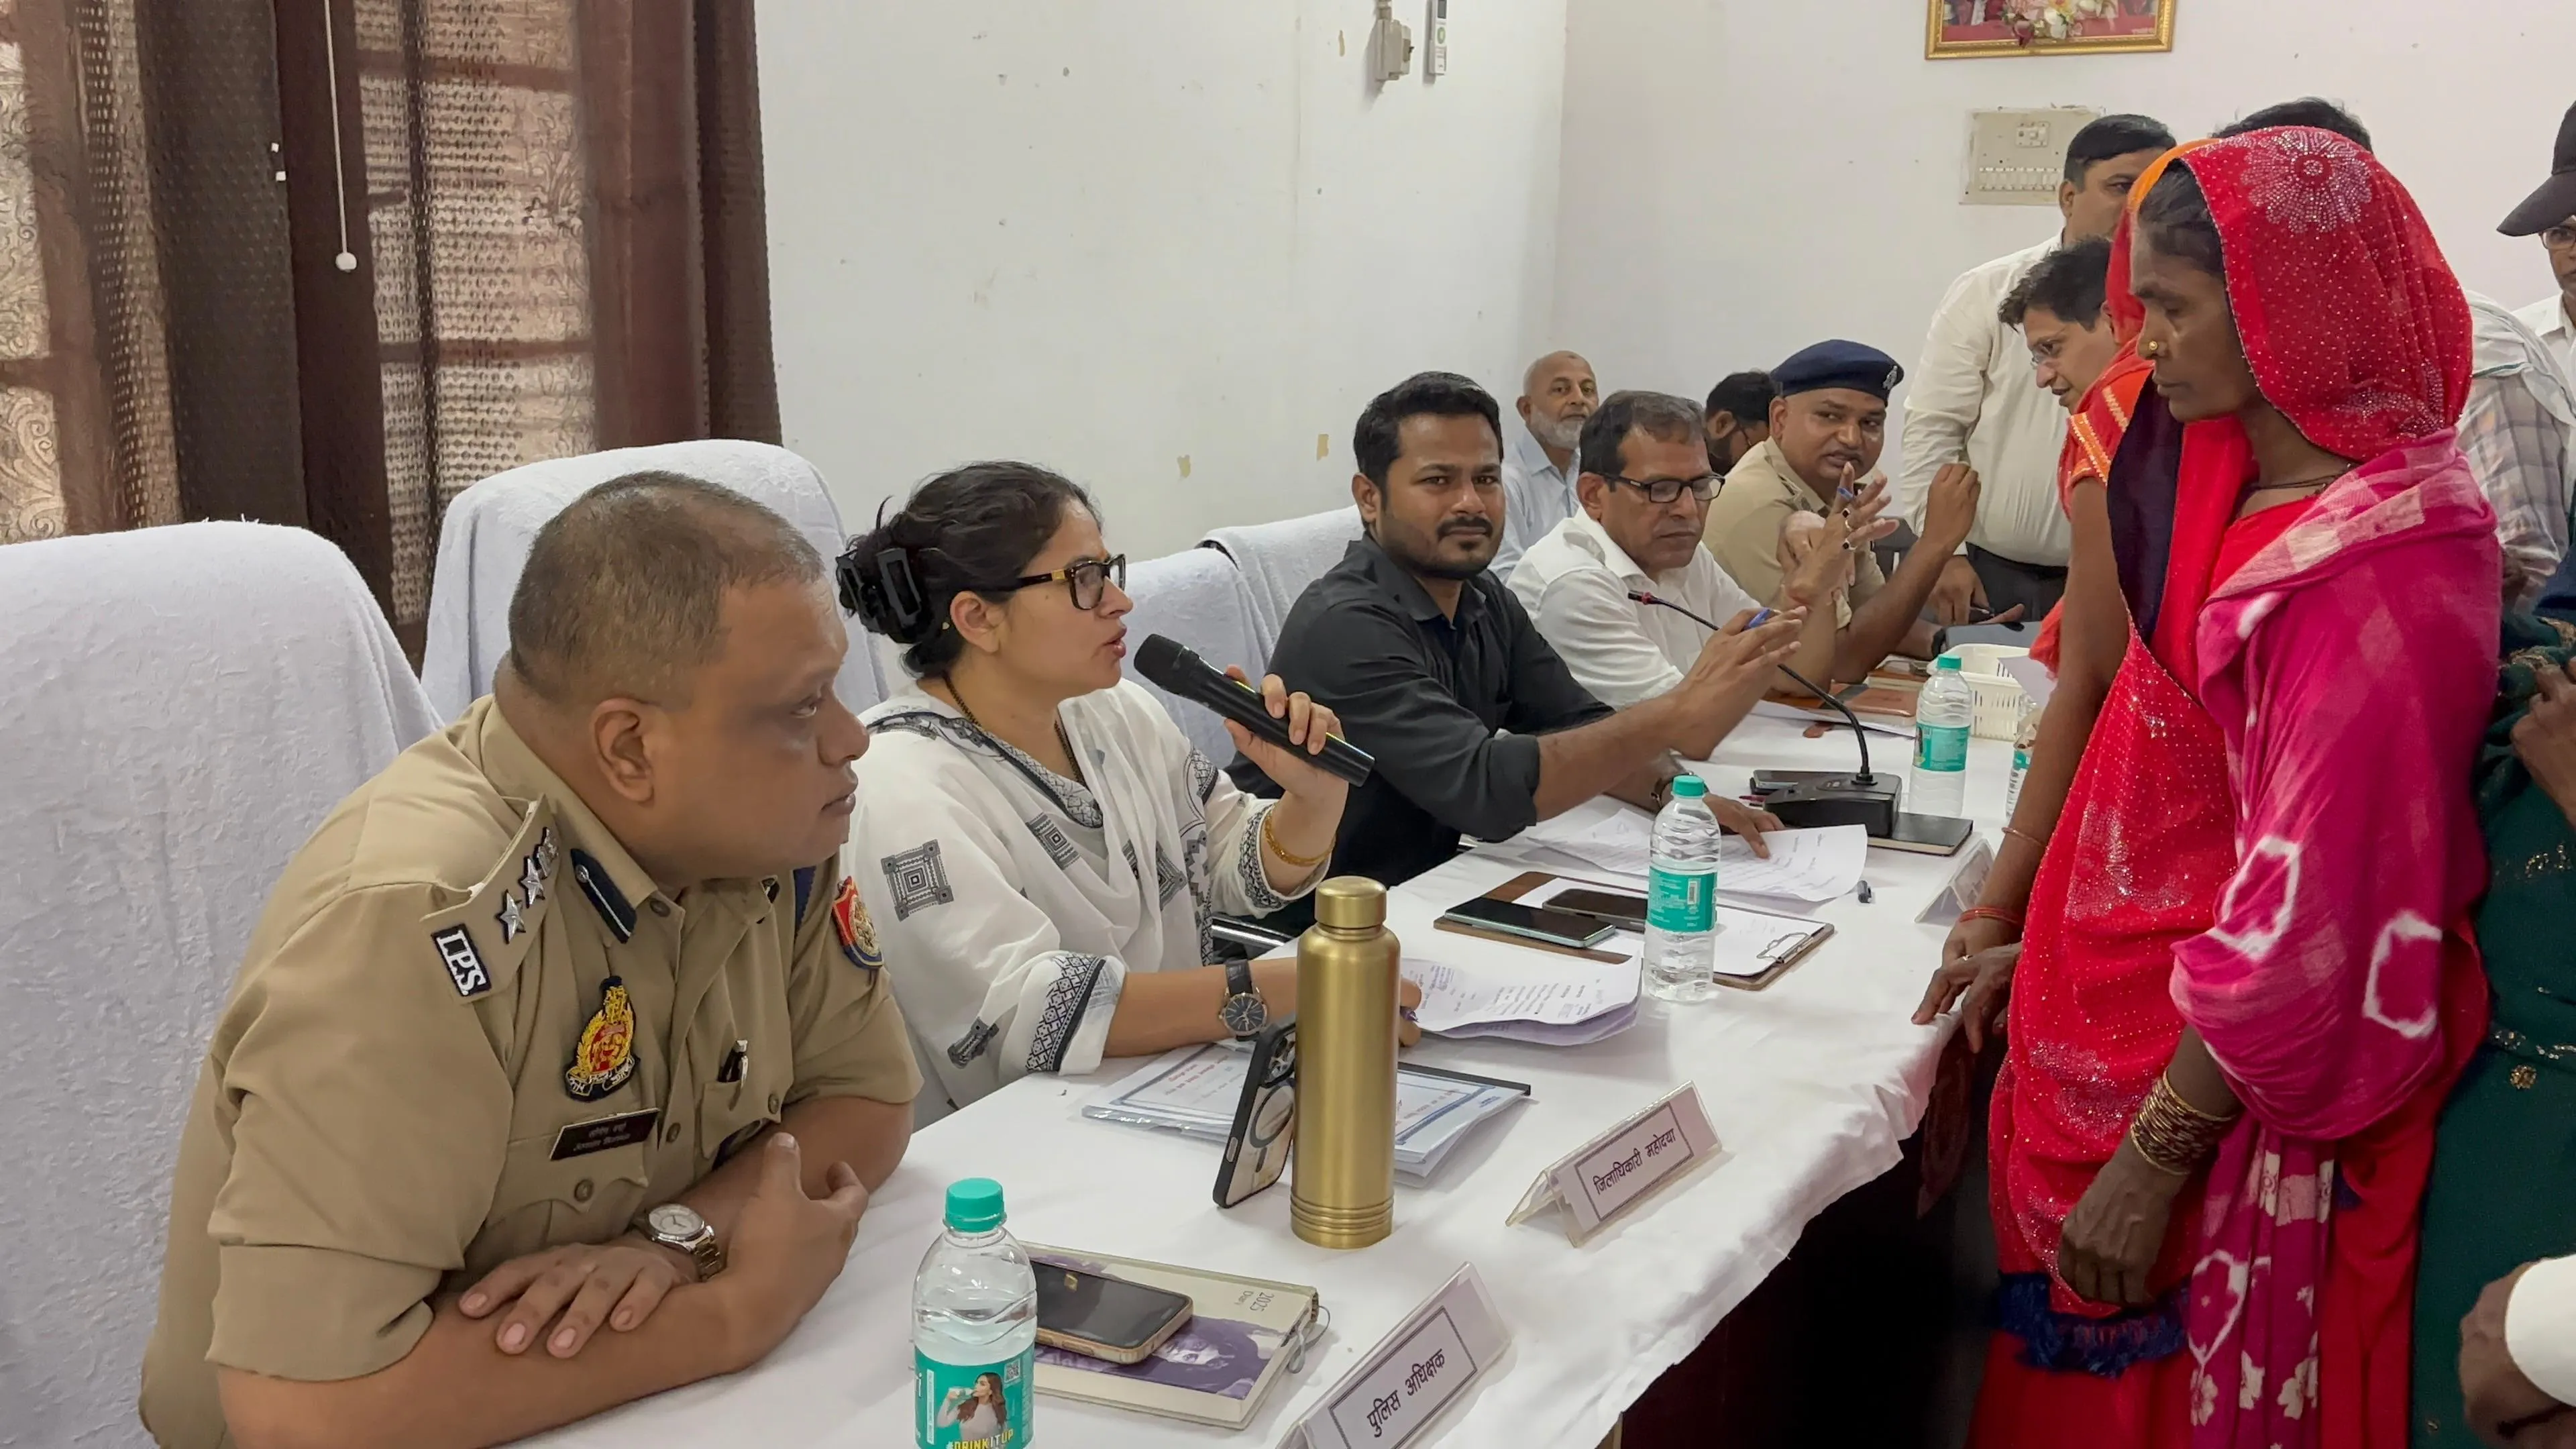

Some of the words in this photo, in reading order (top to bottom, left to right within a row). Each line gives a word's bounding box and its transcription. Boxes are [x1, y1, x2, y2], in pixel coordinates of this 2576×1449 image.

[1593, 1148, 1642, 1195] जिलाधिकारी
[1645, 1128, 1676, 1157] महोदया
[1366, 1389, 1401, 1438] पुलिस
